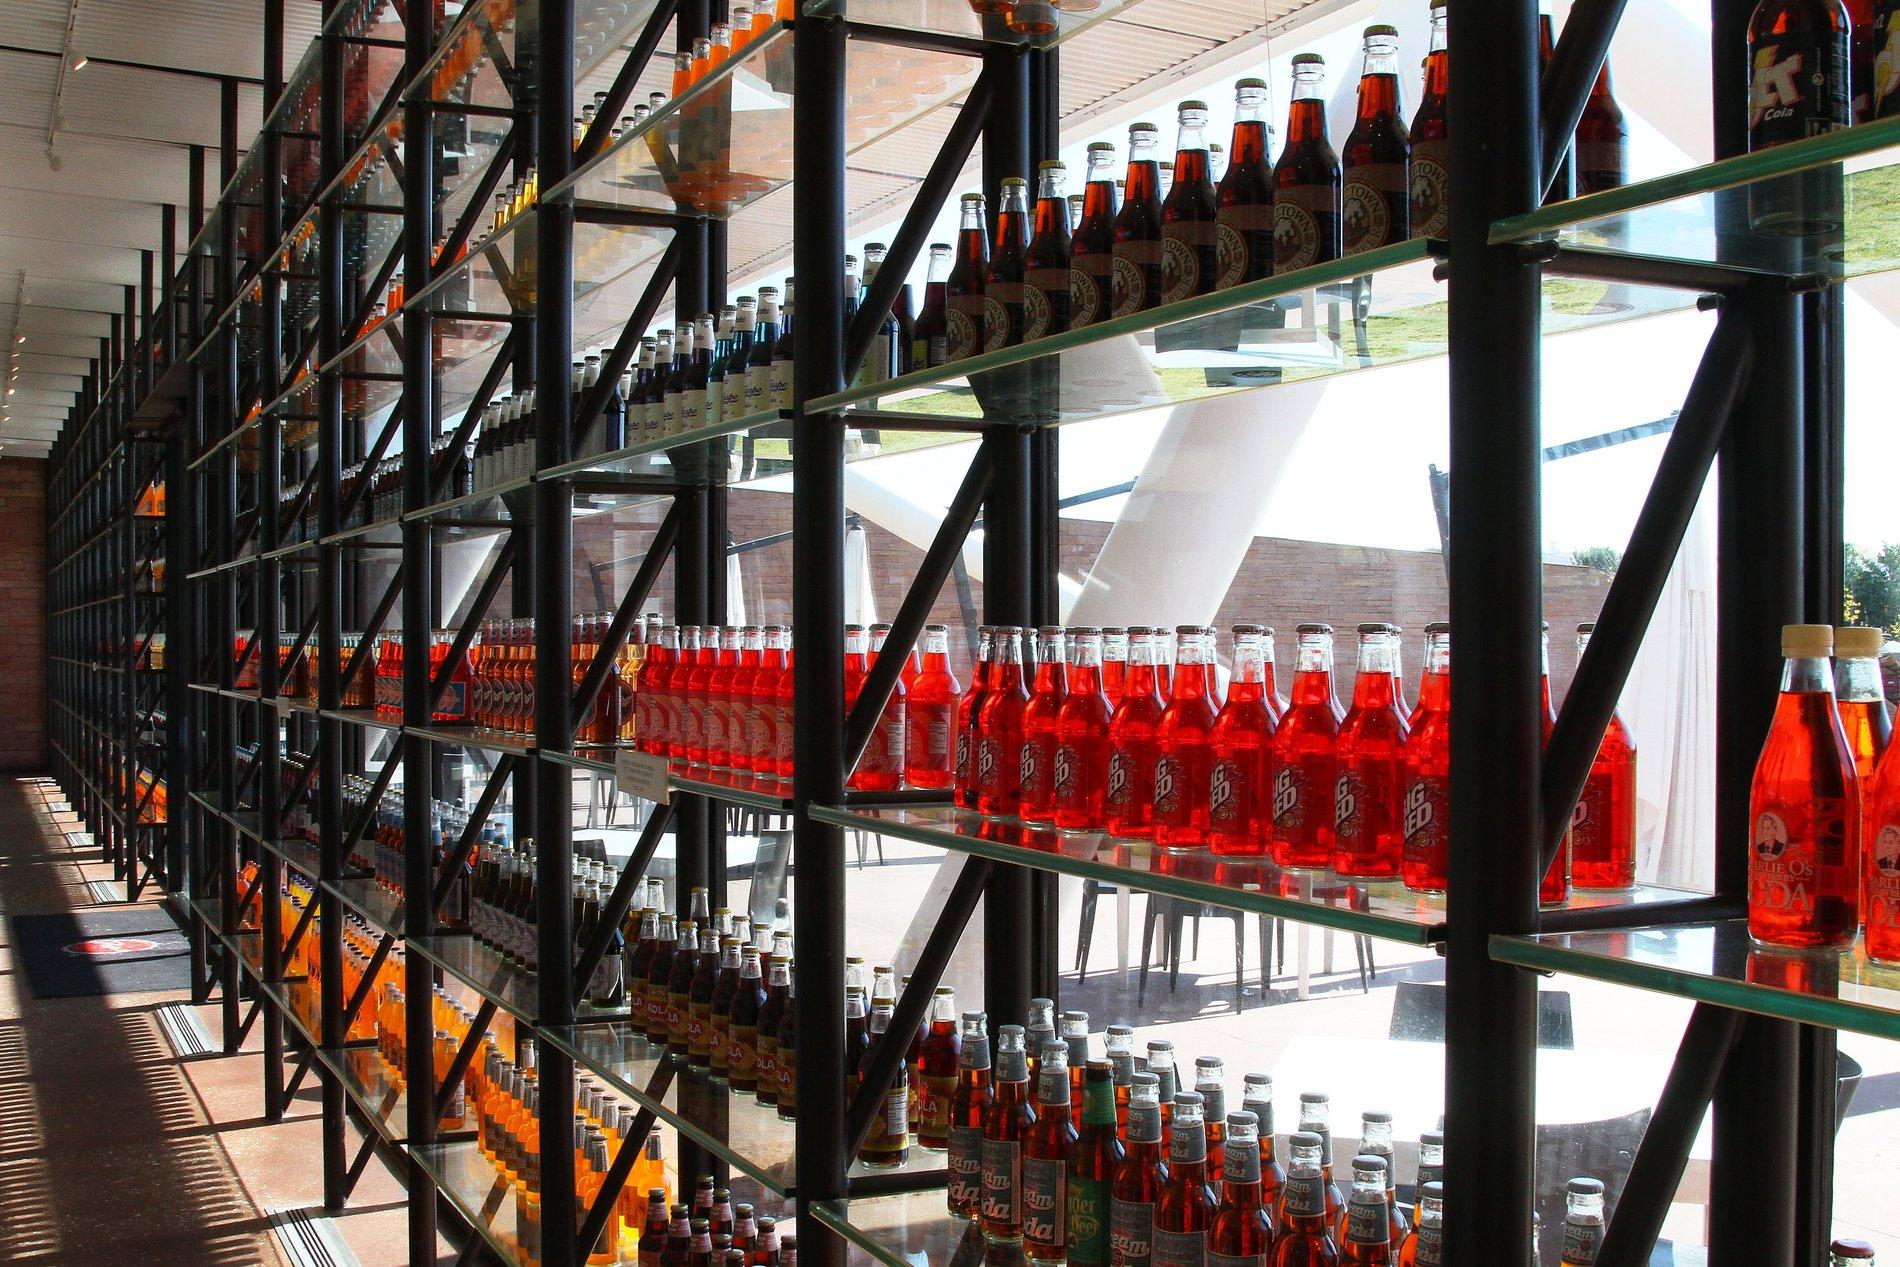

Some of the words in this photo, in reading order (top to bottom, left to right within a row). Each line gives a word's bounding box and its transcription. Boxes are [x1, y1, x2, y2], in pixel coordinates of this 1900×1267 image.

[1764, 107, 1794, 122] Cola
[1109, 768, 1125, 797] ED
[1155, 774, 1173, 804] ED
[1211, 764, 1225, 790] IG
[1275, 768, 1291, 799] IG
[1211, 780, 1231, 813] ED
[1273, 786, 1297, 821] ED
[1404, 782, 1425, 819] IG
[1335, 793, 1355, 827] ED
[632, 996, 643, 1008] LA
[756, 1058, 775, 1069] OLA
[777, 1071, 791, 1083] LA
[917, 1100, 937, 1114] OLA
[949, 1181, 982, 1202] da
[982, 1197, 1011, 1219] da
[1024, 1217, 1054, 1239] da
